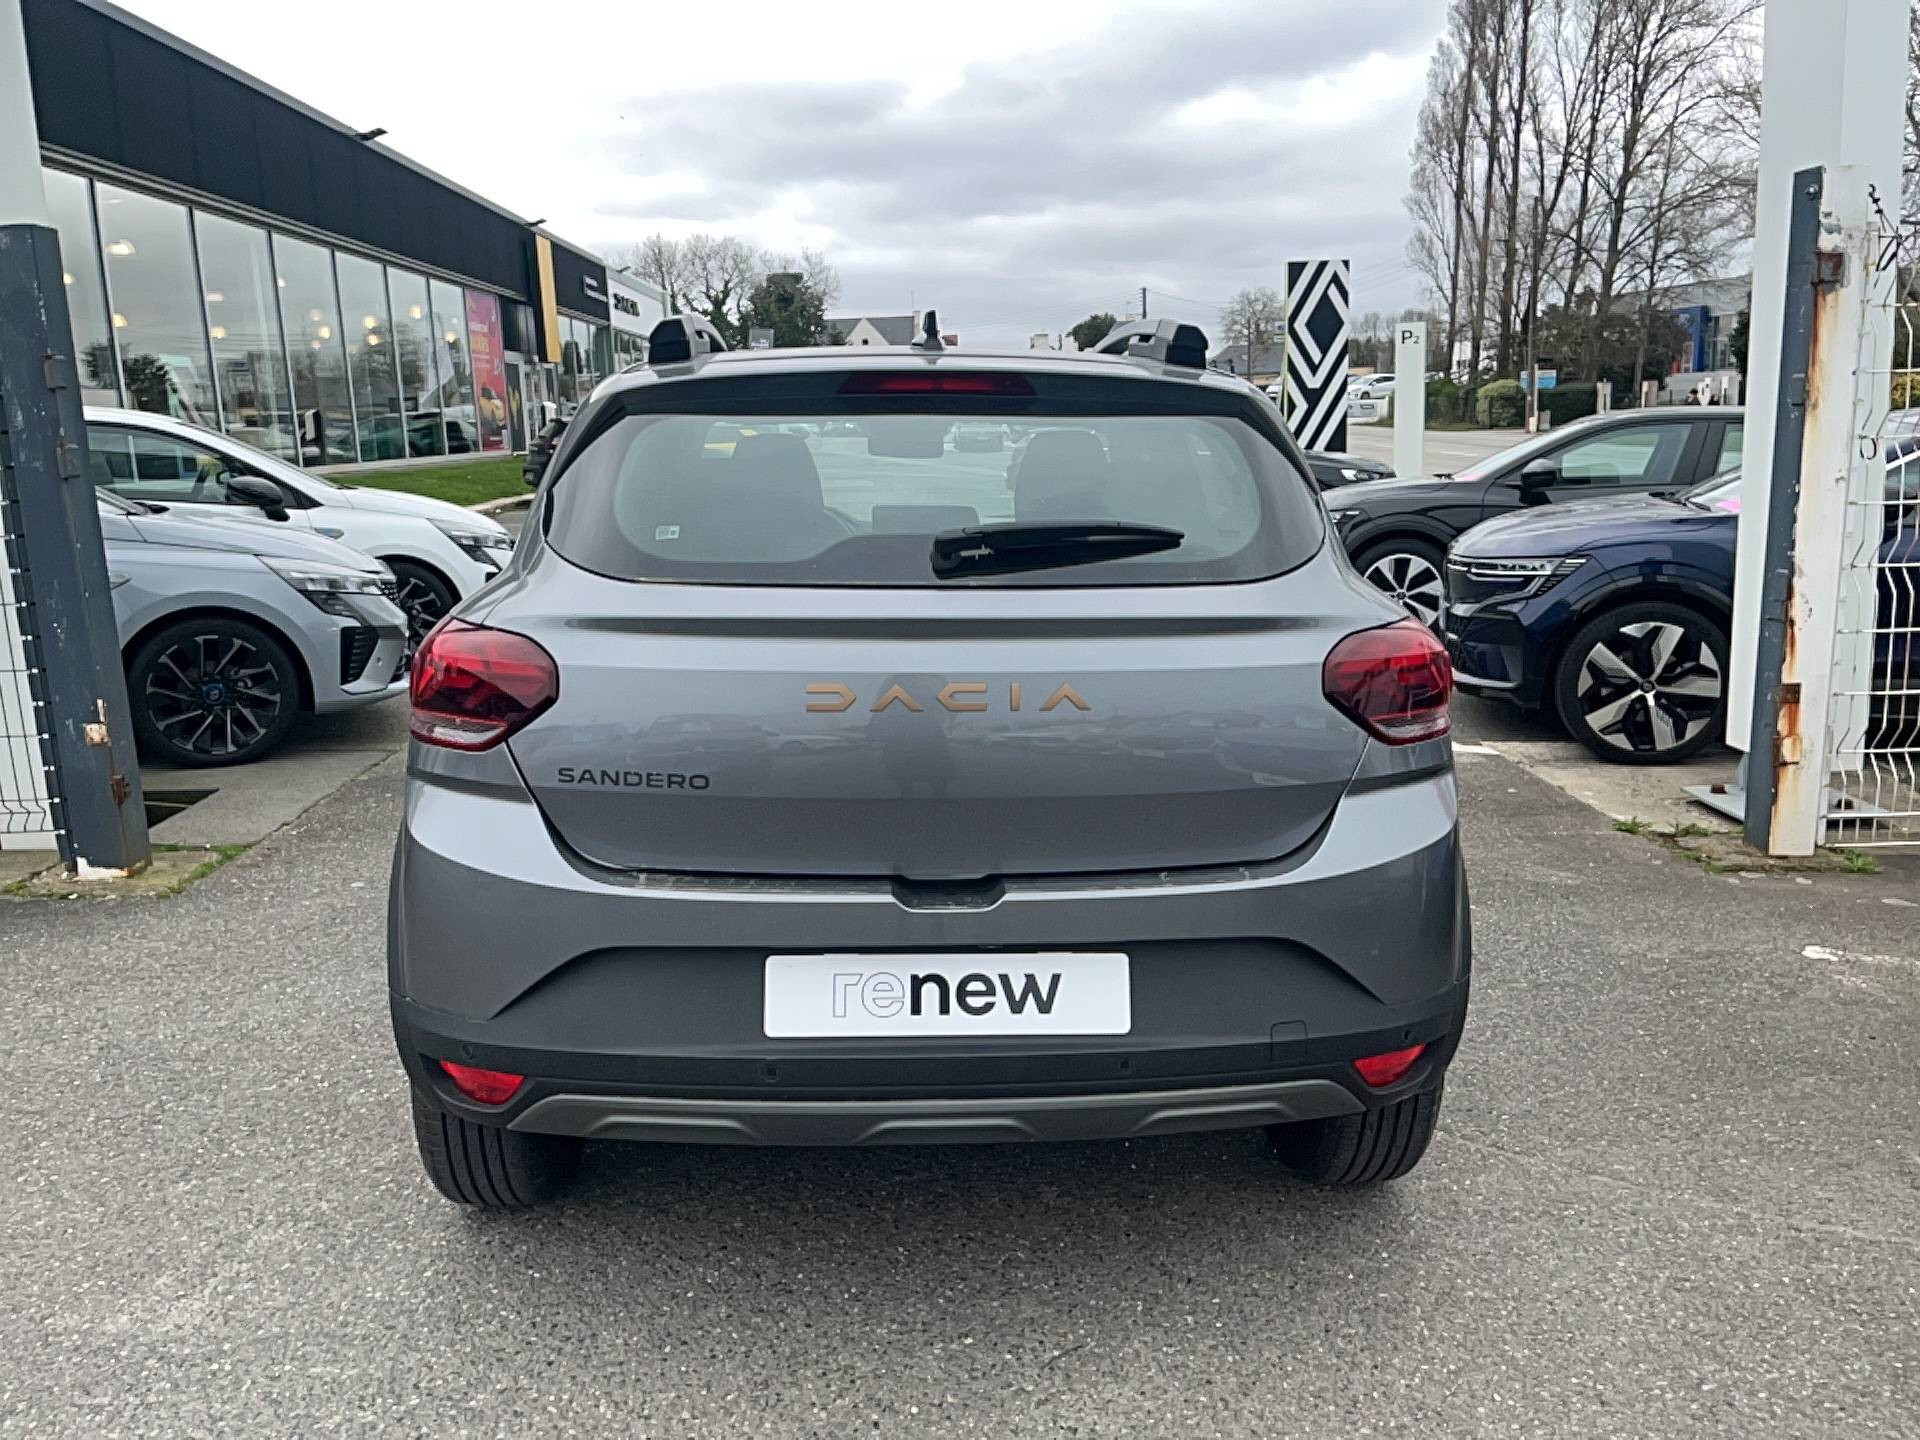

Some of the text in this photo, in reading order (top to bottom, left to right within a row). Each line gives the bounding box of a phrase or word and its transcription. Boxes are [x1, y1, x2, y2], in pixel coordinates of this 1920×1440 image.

[805, 682, 1092, 712] DACIA
[557, 767, 711, 790] SANDERO
[832, 972, 1062, 1018] renew
